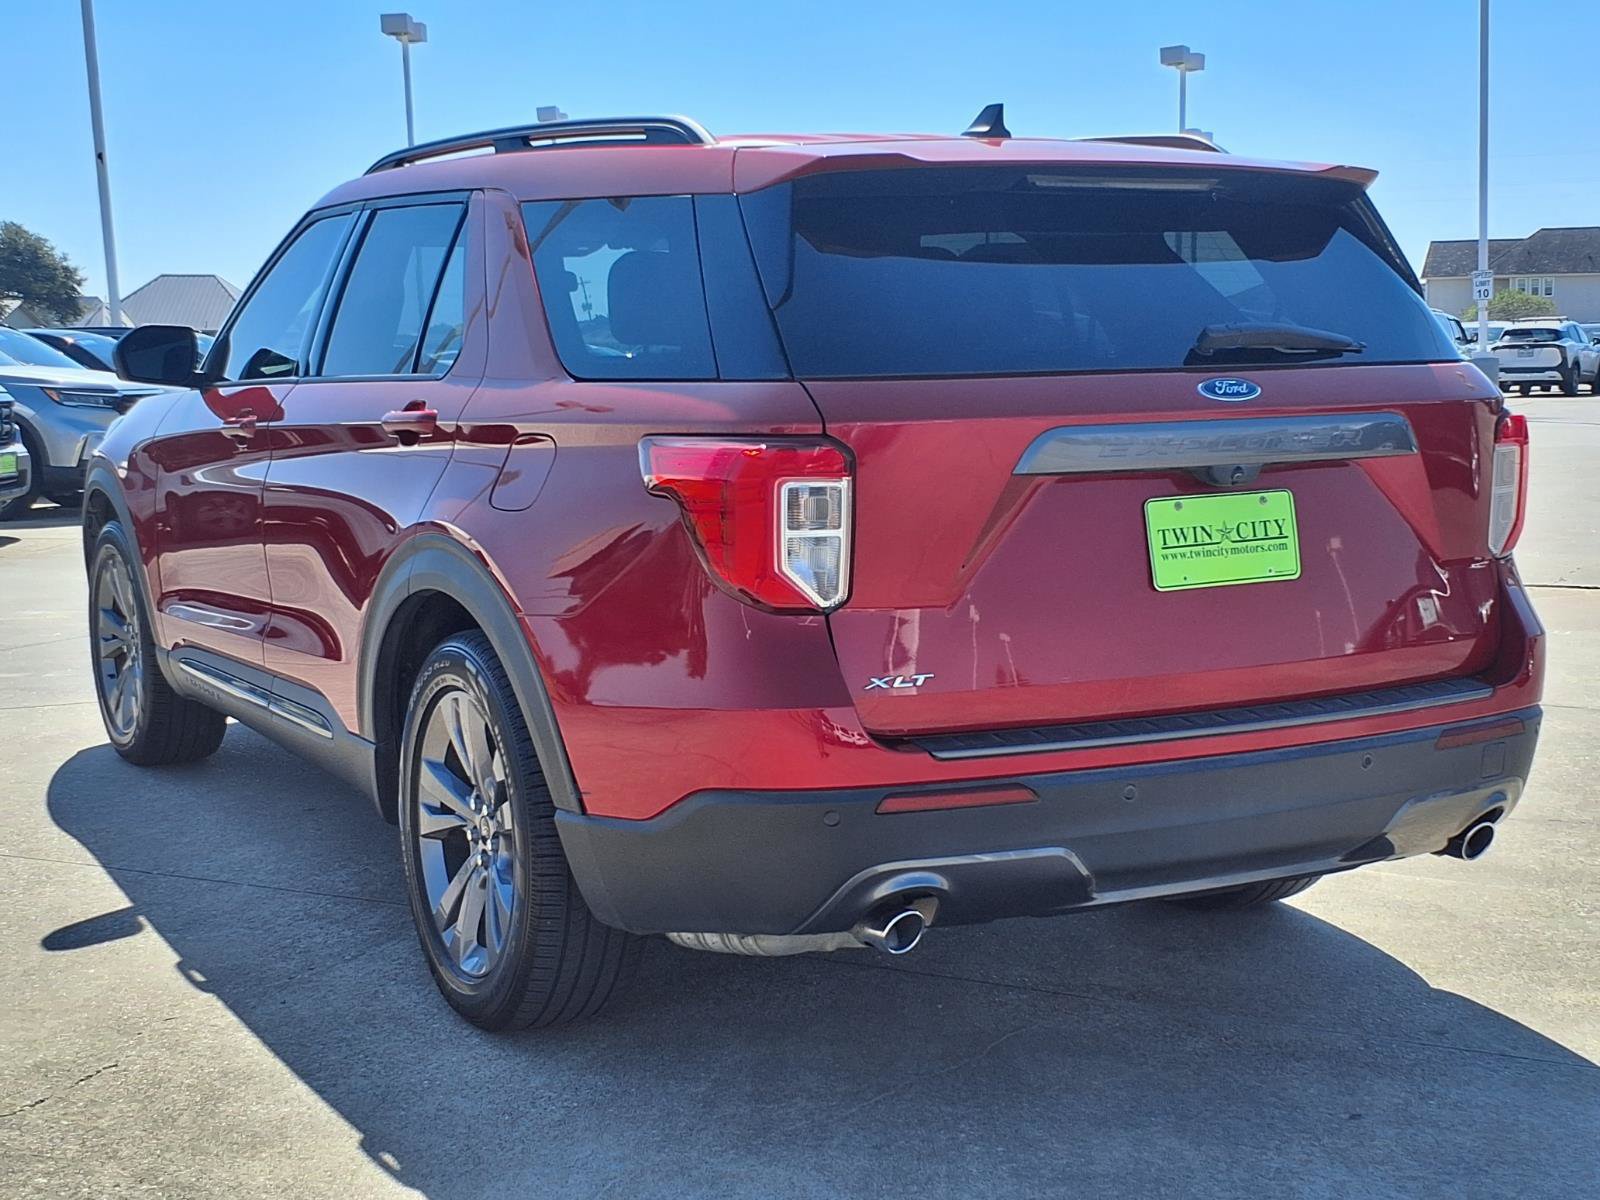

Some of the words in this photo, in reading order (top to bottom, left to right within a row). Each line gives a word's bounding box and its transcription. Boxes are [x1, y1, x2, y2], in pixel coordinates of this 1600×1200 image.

[1476, 289, 1489, 298] 10
[1215, 380, 1248, 394] Ford
[1098, 427, 1365, 458] EXPLORER
[1157, 525, 1213, 546] TWIN
[1236, 518, 1286, 539] CITY
[1160, 541, 1288, 561] www.twincitymotors.com
[863, 673, 935, 690] XLT
